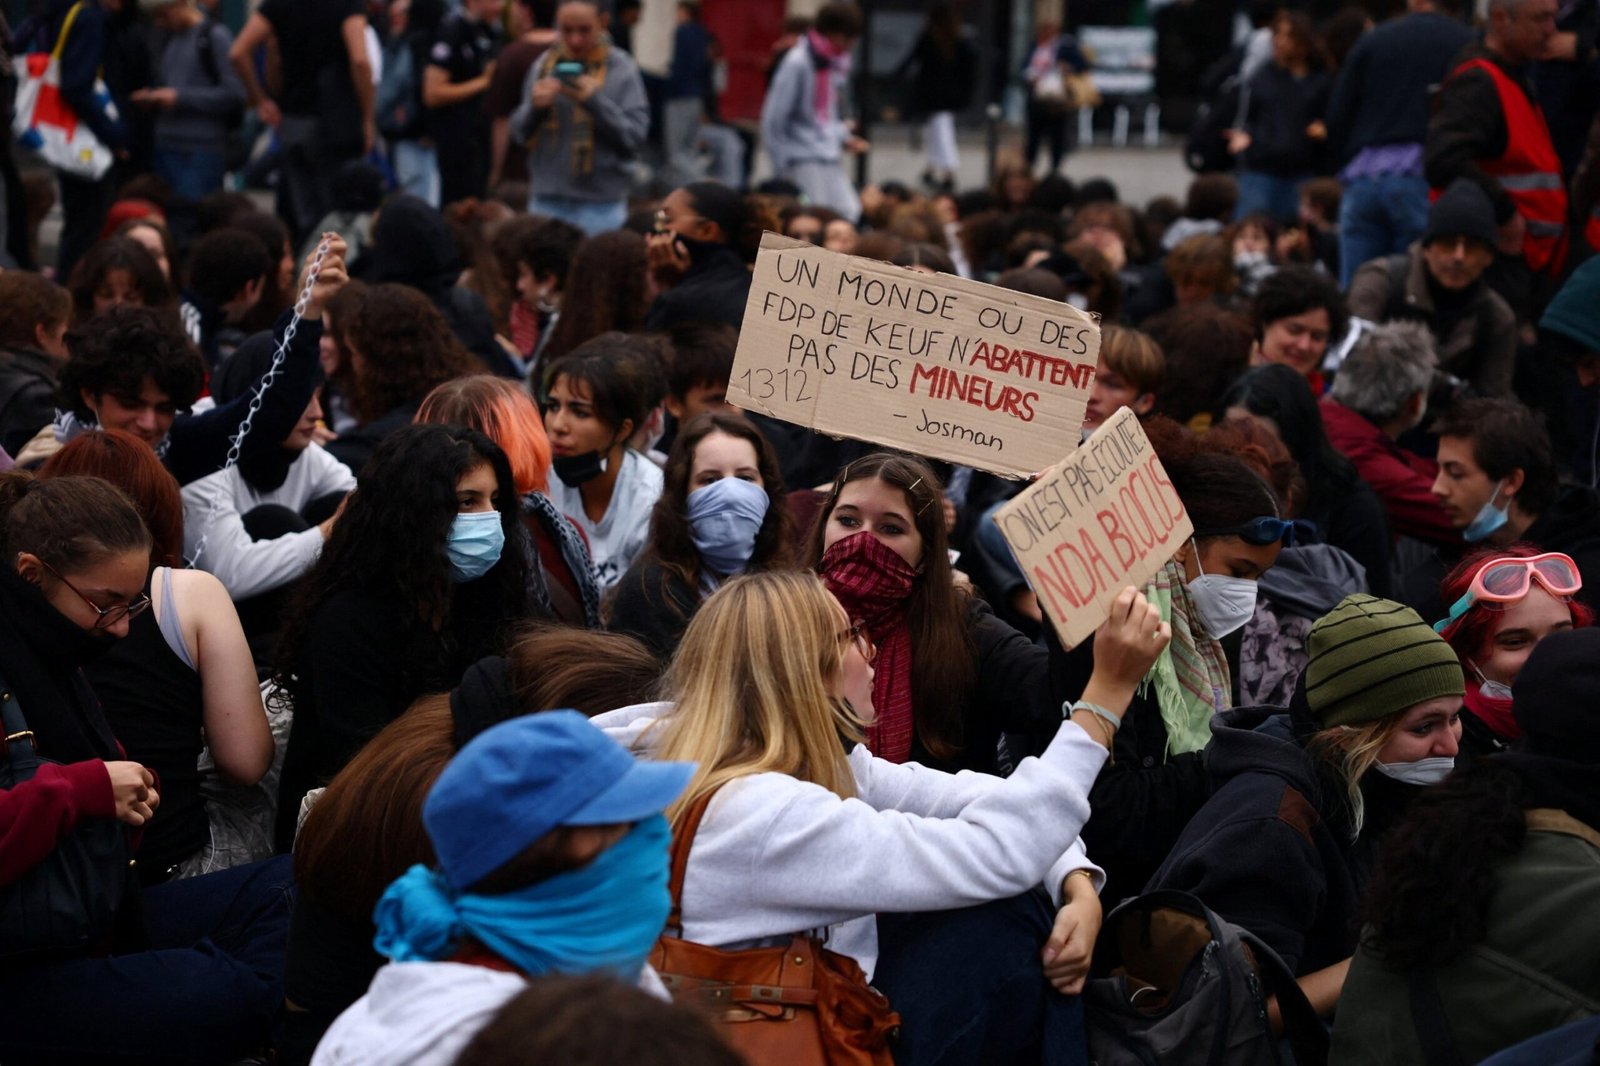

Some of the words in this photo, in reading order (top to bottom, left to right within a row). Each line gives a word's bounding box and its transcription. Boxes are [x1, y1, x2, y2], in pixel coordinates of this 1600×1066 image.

[763, 291, 816, 328] FDP
[821, 310, 853, 339] DE
[865, 317, 944, 357] KEUF
[949, 335, 1095, 390] N'ABATTENT
[776, 253, 820, 288] UN
[837, 271, 958, 321] MONDE
[1040, 319, 1090, 355] DES
[740, 367, 812, 402] 1312
[787, 333, 838, 375] PAS
[850, 351, 902, 390] DES
[909, 362, 1040, 422] MINEURS
[915, 409, 1003, 451] Josman
[1003, 502, 1046, 551] ON
[1031, 477, 1073, 532] EST
[1062, 455, 1104, 507] PAS
[1033, 527, 1120, 624] NDA
[1096, 453, 1185, 573] BLOCUS
